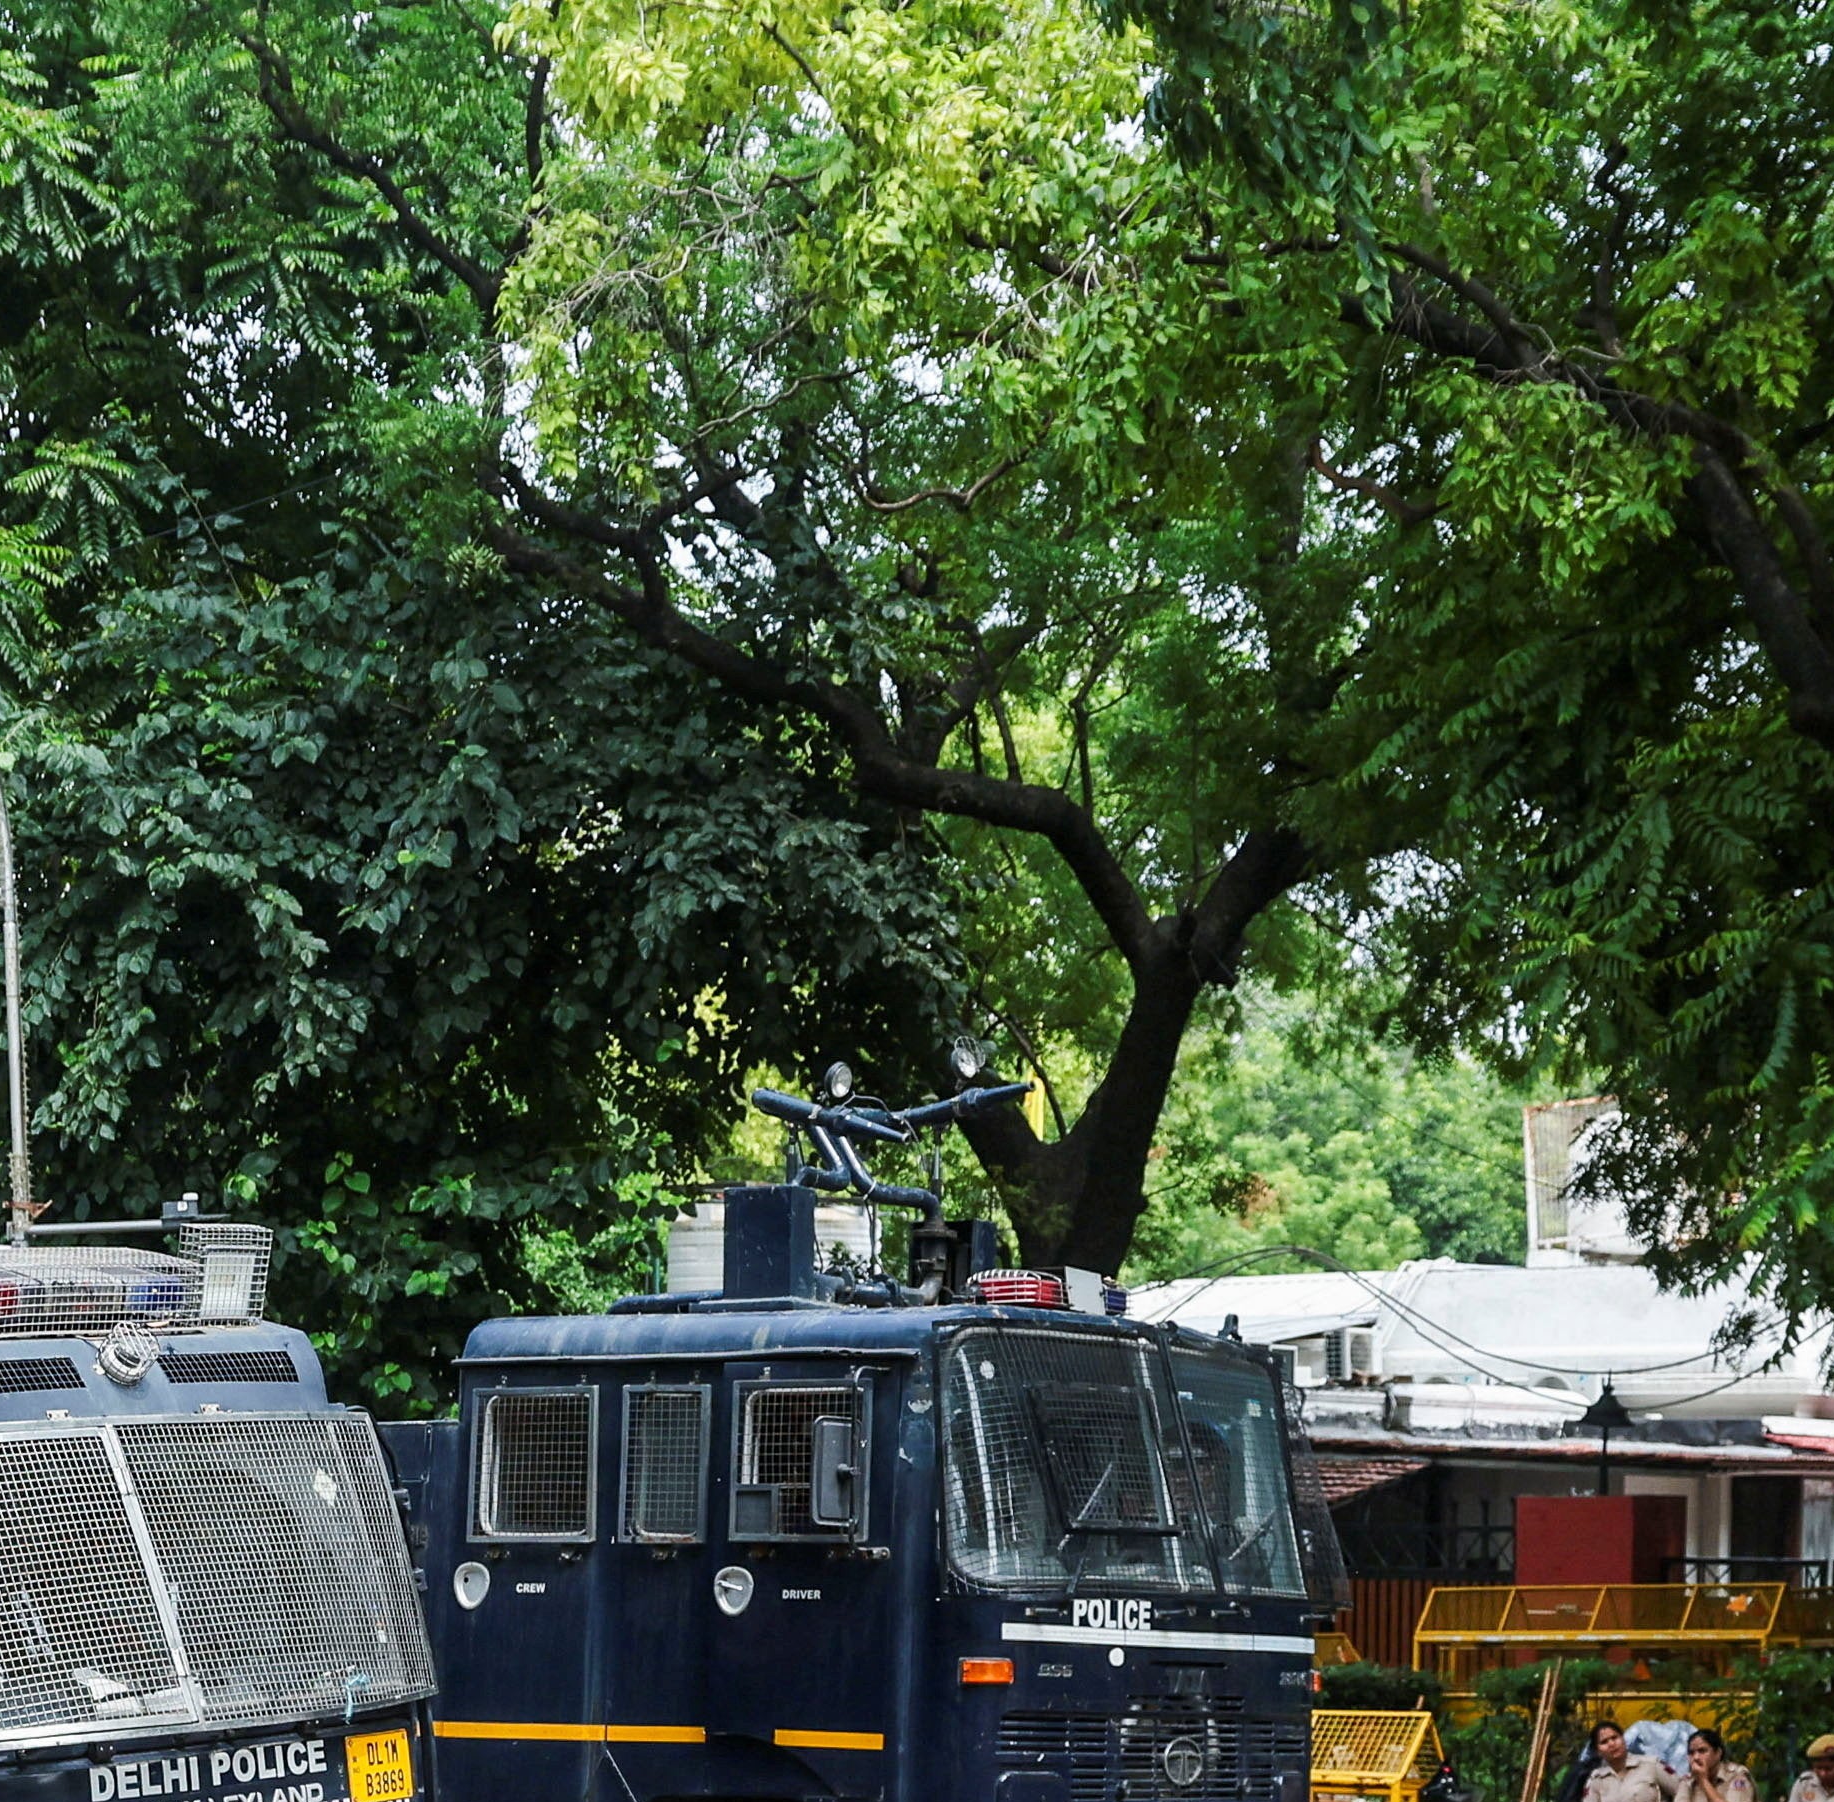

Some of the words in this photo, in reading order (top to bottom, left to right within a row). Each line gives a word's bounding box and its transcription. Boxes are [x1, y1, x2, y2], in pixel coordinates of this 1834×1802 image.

[516, 1583, 546, 1593] CREW
[782, 1589, 821, 1599] DRIVER
[1073, 1599, 1151, 1630] POLICE
[89, 1755, 200, 1802] DELHI
[211, 1740, 328, 1786] POLICE
[365, 1768, 405, 1797] B3869
